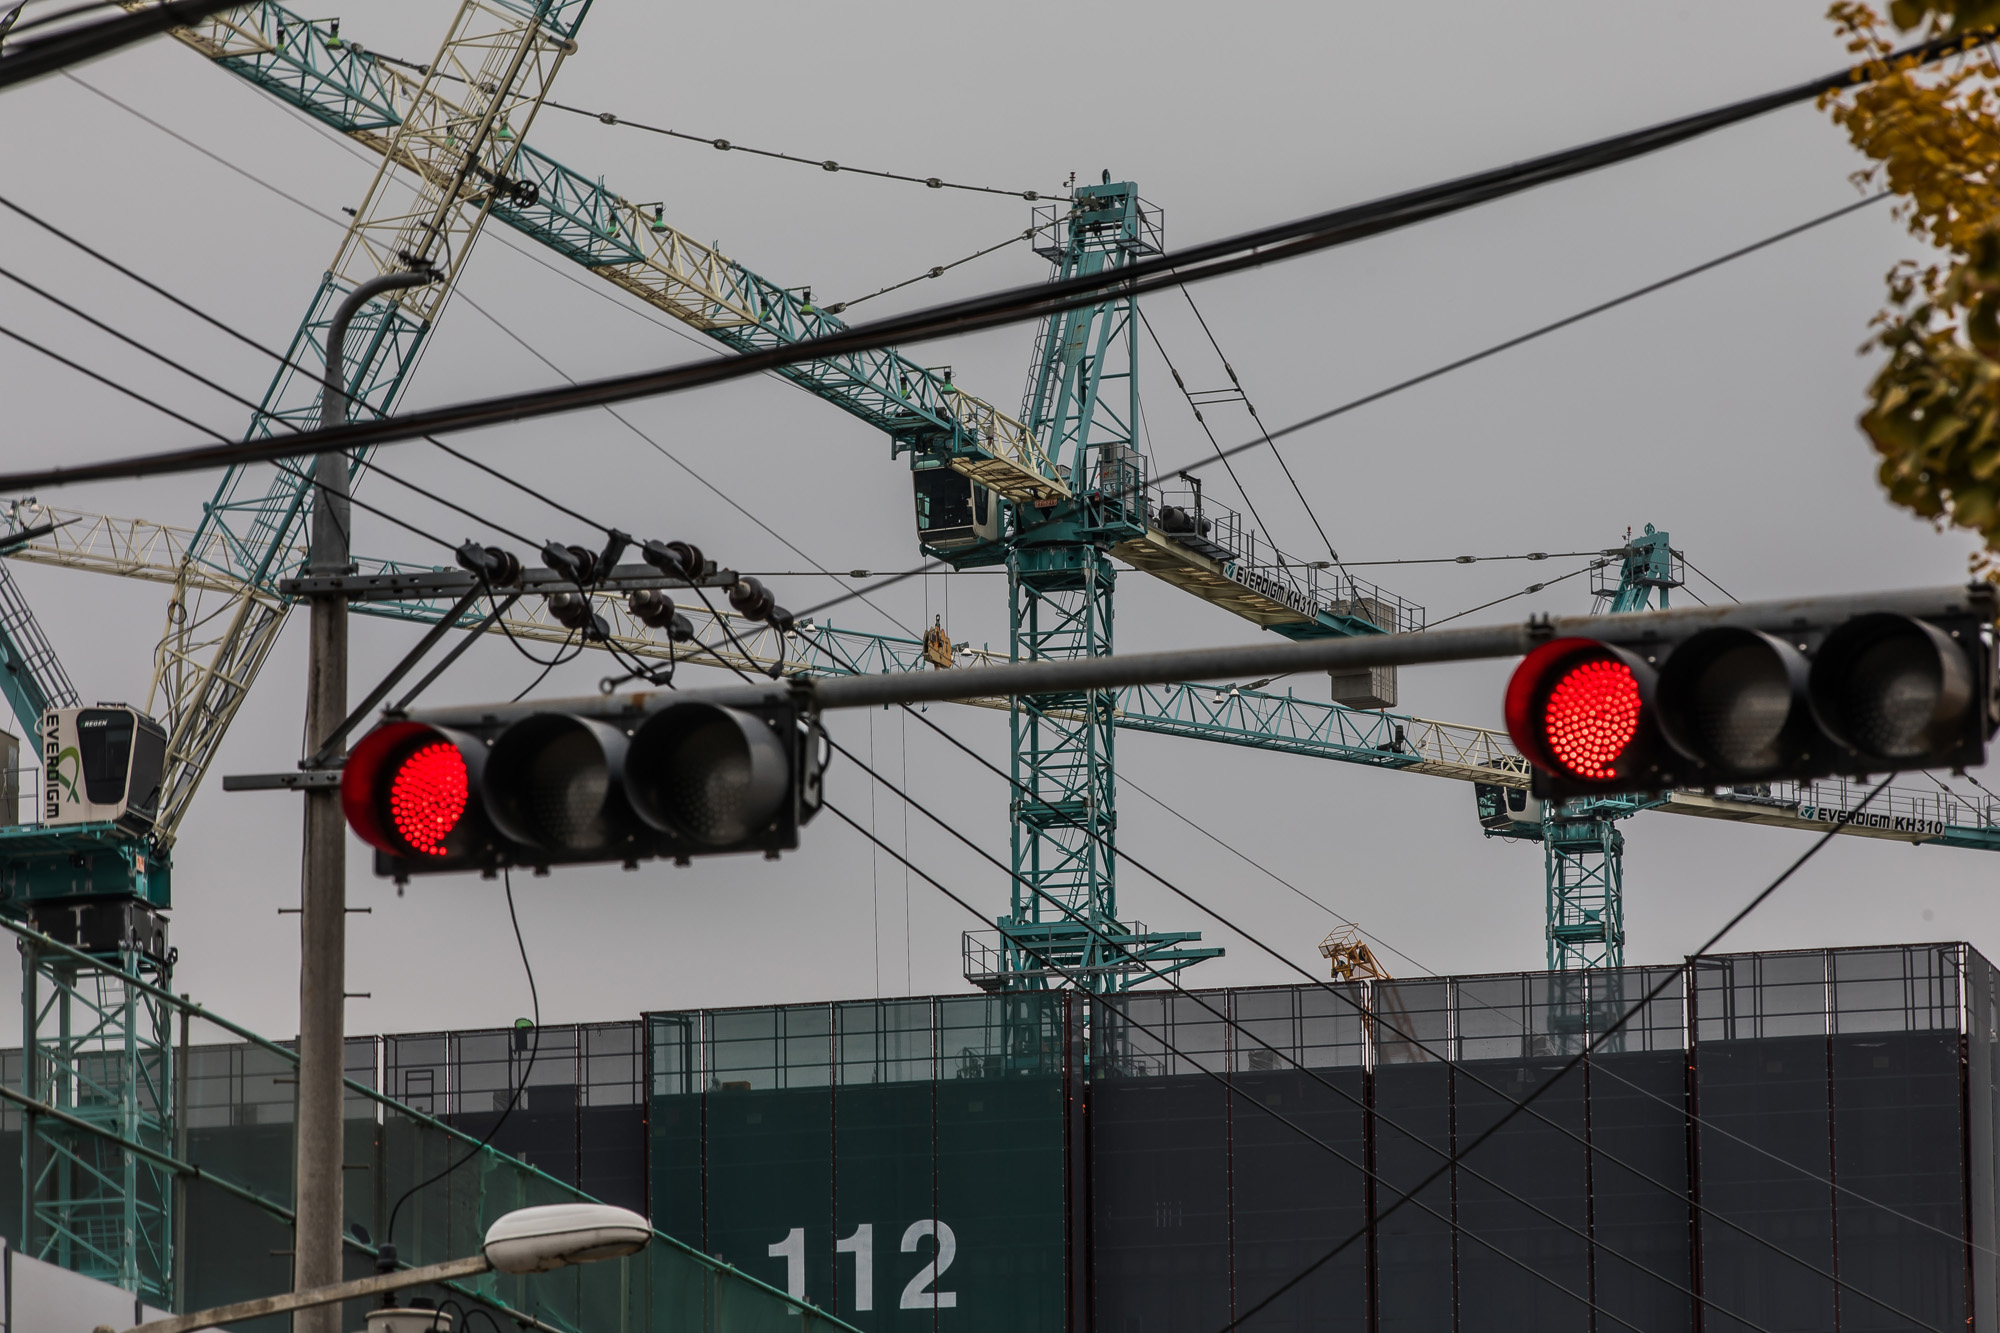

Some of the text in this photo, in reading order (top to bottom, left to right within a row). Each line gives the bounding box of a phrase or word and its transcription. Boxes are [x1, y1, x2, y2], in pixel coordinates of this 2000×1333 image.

[1236, 567, 1318, 618] EVERDIGM KH310
[46, 714, 59, 819] EVERDIGM
[1818, 809, 1943, 835] EVERDIGM KH310
[768, 1219, 957, 1315] 112
